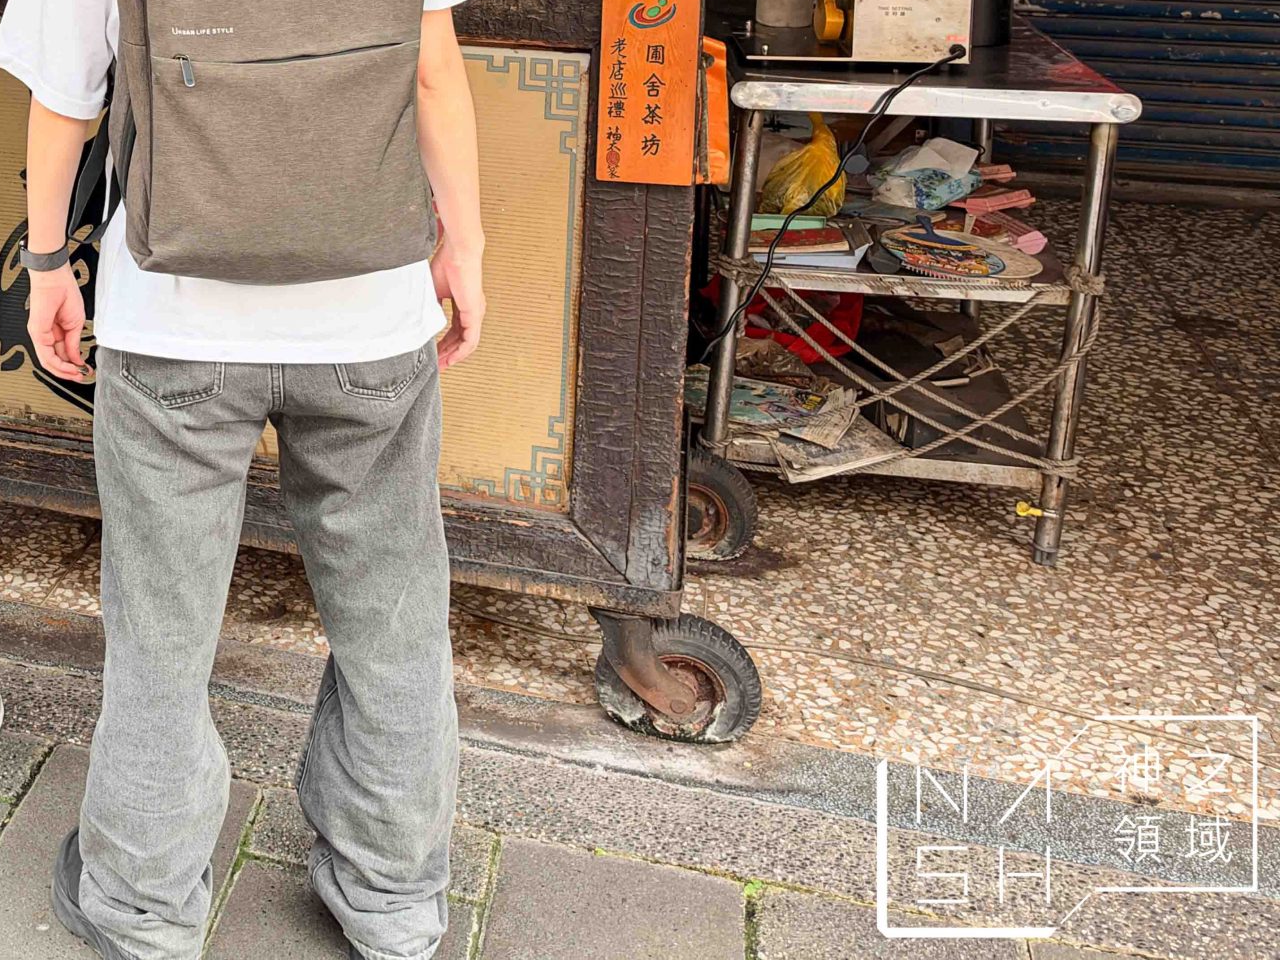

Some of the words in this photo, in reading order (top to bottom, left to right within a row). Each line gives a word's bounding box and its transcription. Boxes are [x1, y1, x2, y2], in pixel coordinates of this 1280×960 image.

[212, 27, 234, 35] STYLE
[607, 37, 628, 119] 老店巡禮
[641, 44, 666, 156] 圃舍茶坊
